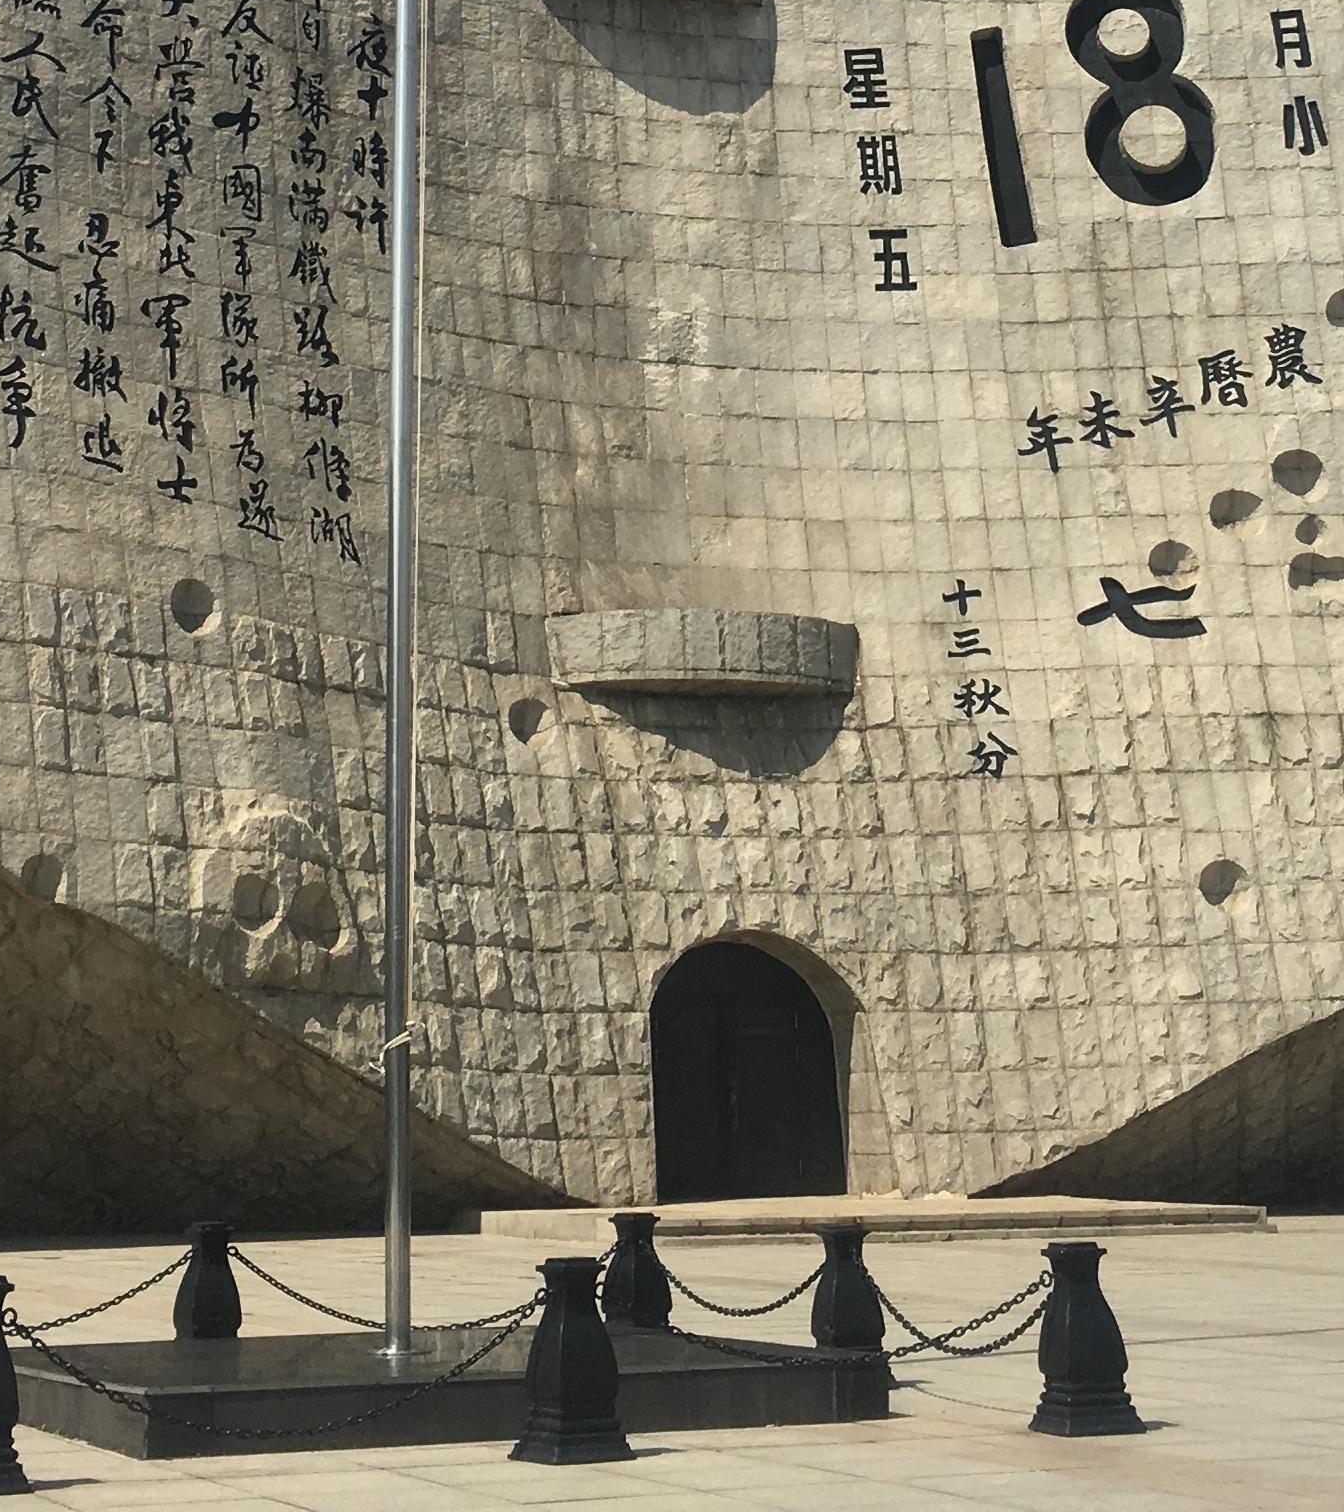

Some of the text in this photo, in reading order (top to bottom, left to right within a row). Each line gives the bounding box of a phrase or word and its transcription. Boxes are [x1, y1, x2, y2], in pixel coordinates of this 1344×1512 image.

[842, 47, 919, 293] 星期五
[942, 578, 1019, 780] 十三秋分
[1076, 576, 1208, 639] 七
